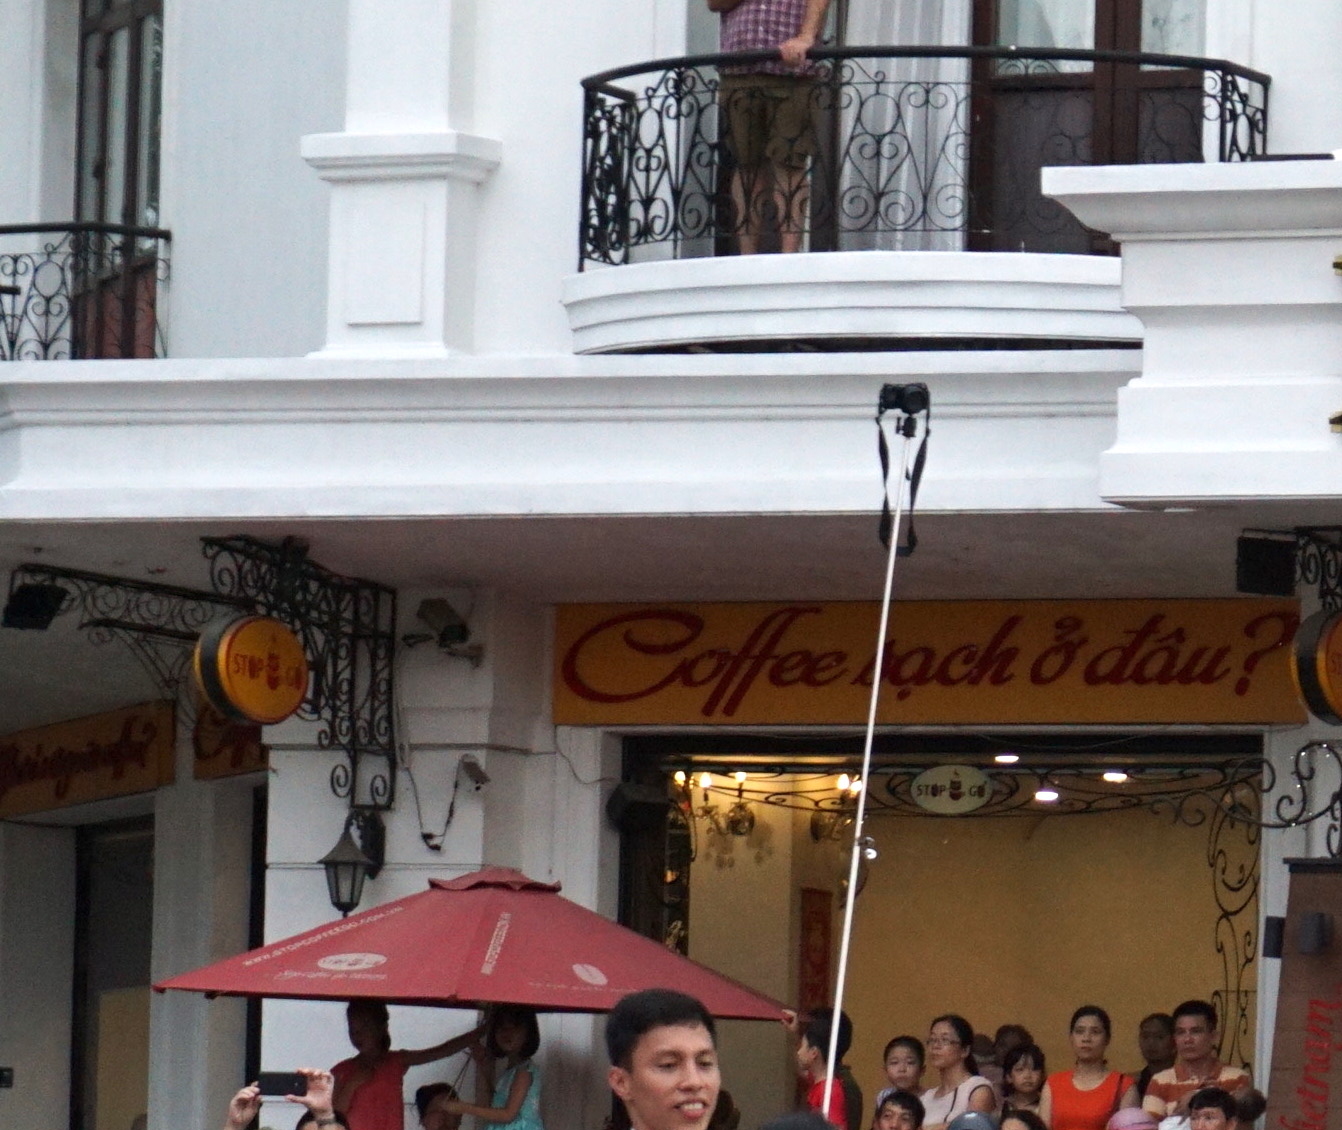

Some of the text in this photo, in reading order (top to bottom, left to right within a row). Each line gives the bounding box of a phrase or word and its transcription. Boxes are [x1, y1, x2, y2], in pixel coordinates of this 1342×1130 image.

[562, 608, 1298, 717] Coffee sạch ở đâu?
[916, 783, 947, 798] STOP
